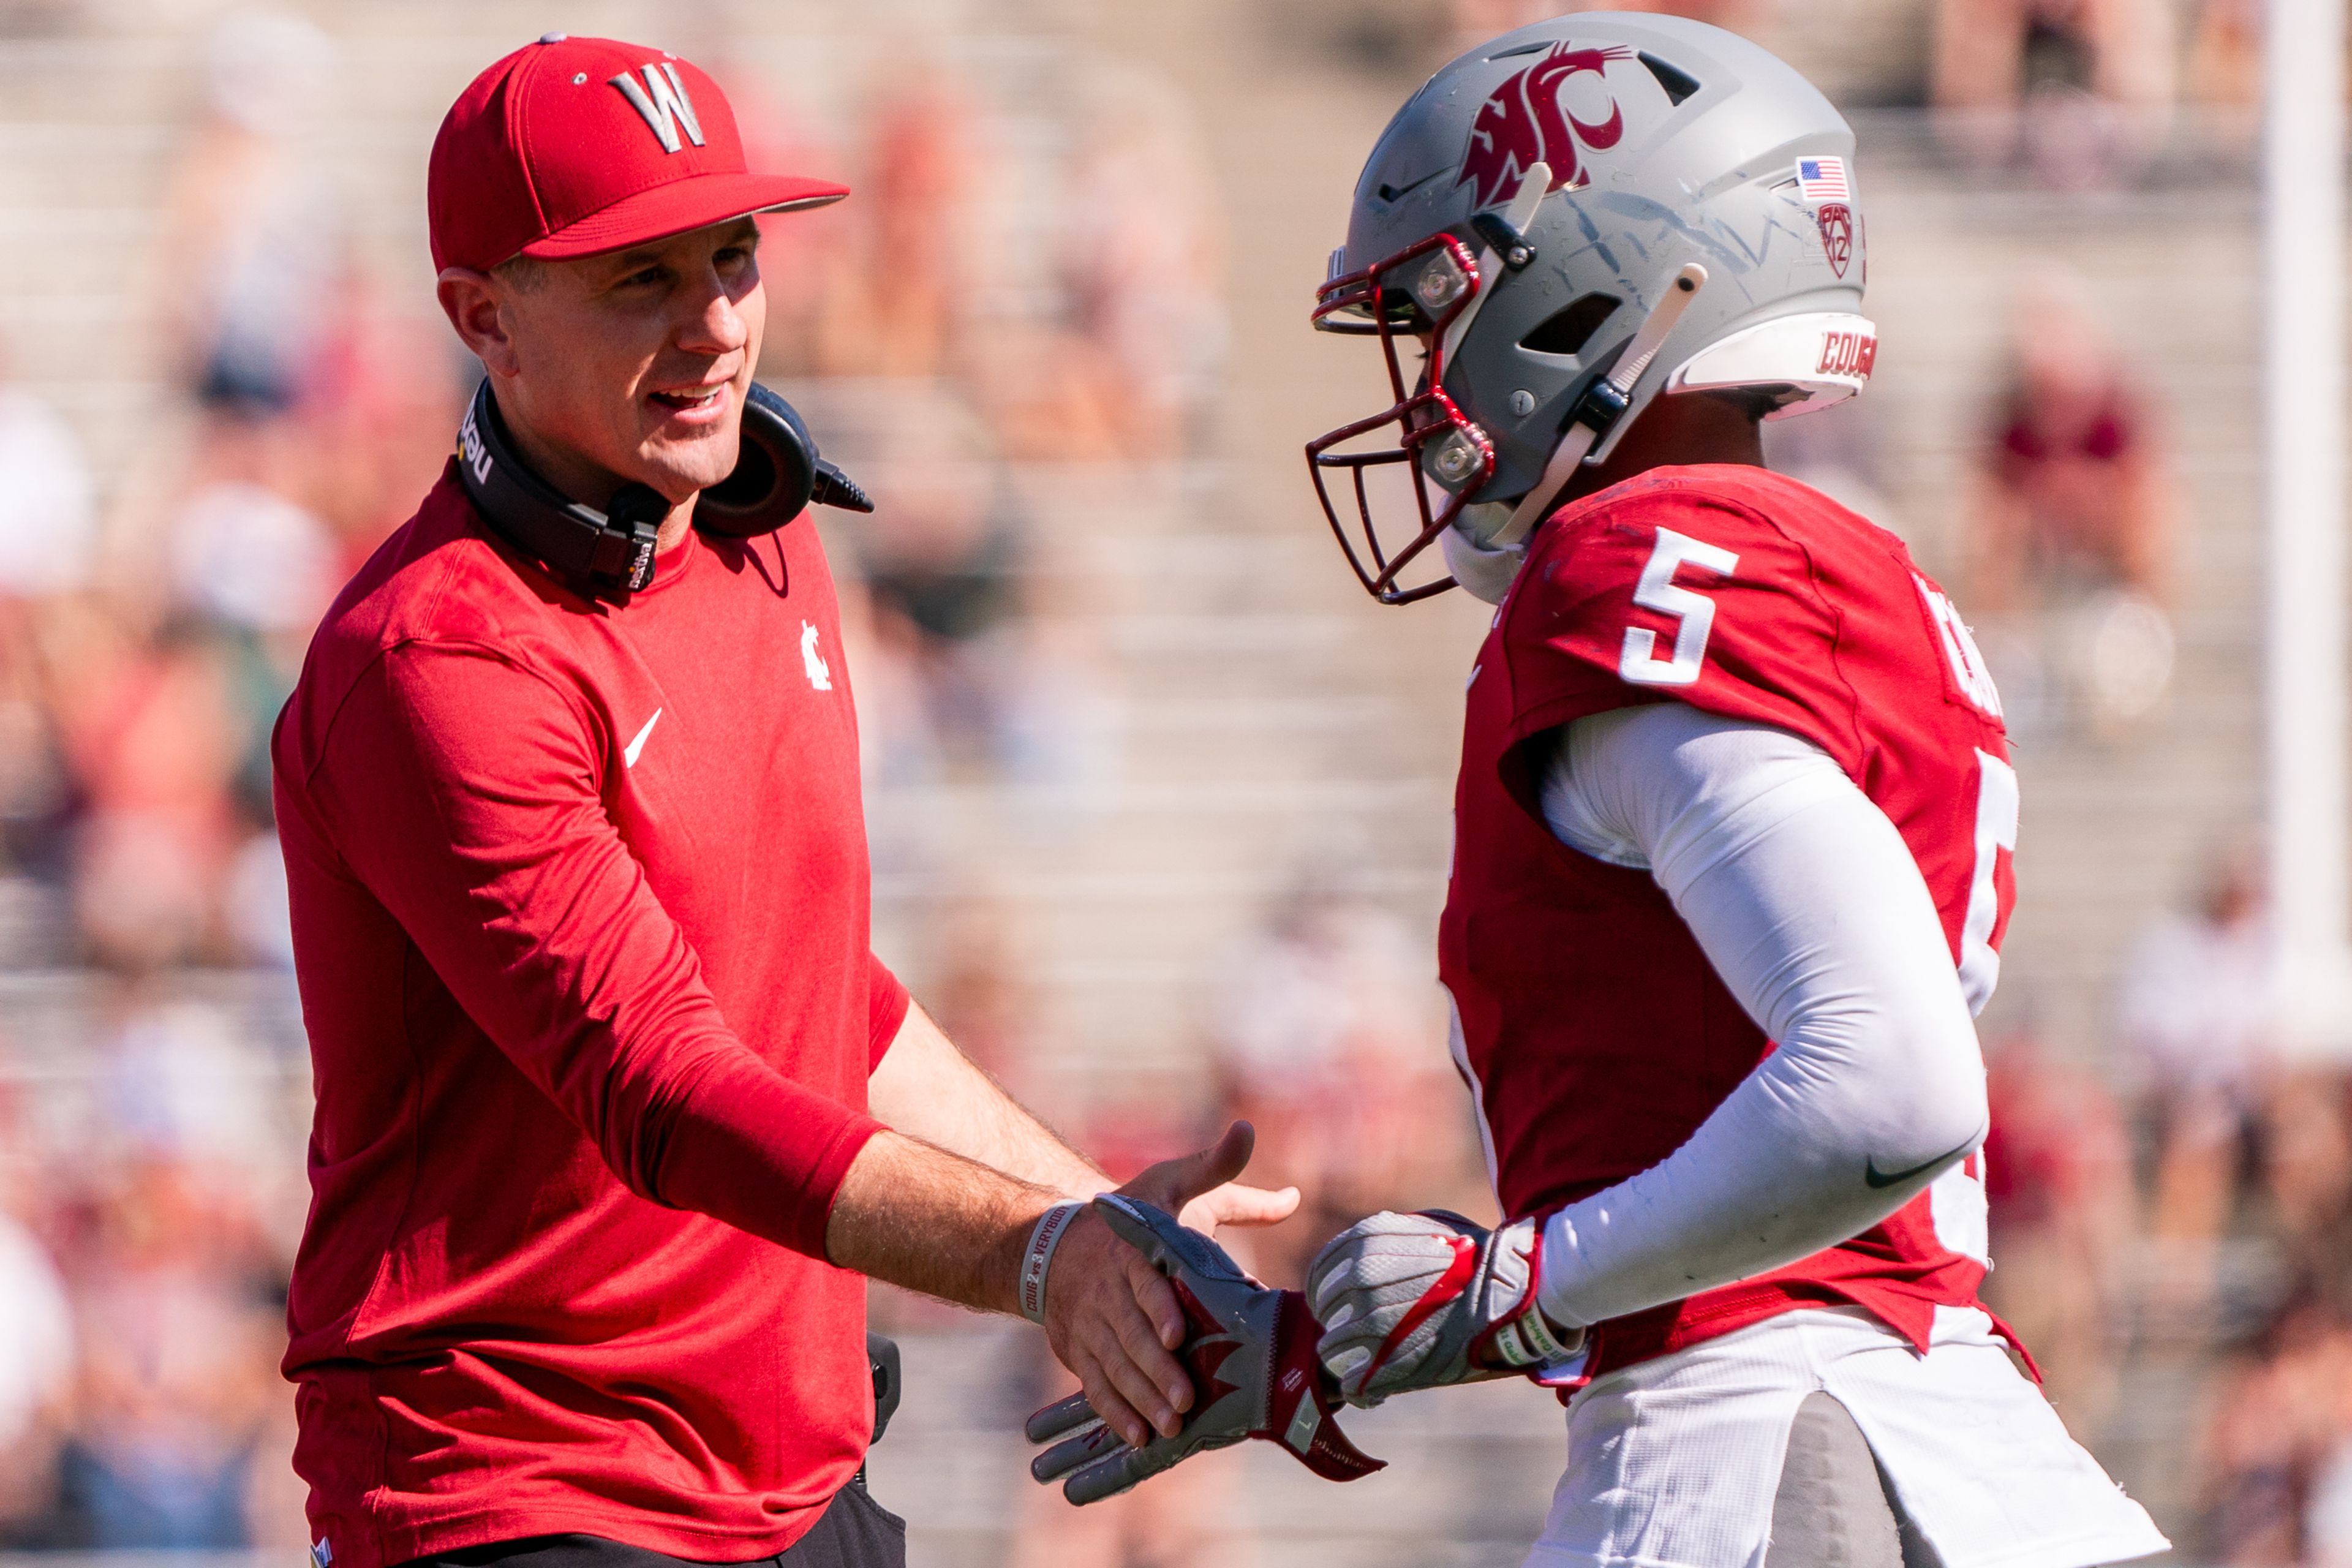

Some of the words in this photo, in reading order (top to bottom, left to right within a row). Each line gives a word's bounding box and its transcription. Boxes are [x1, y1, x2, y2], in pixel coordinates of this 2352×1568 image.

[607, 62, 706, 154] W
[1832, 235, 1847, 262] 12
[1619, 526, 1740, 684] 5
